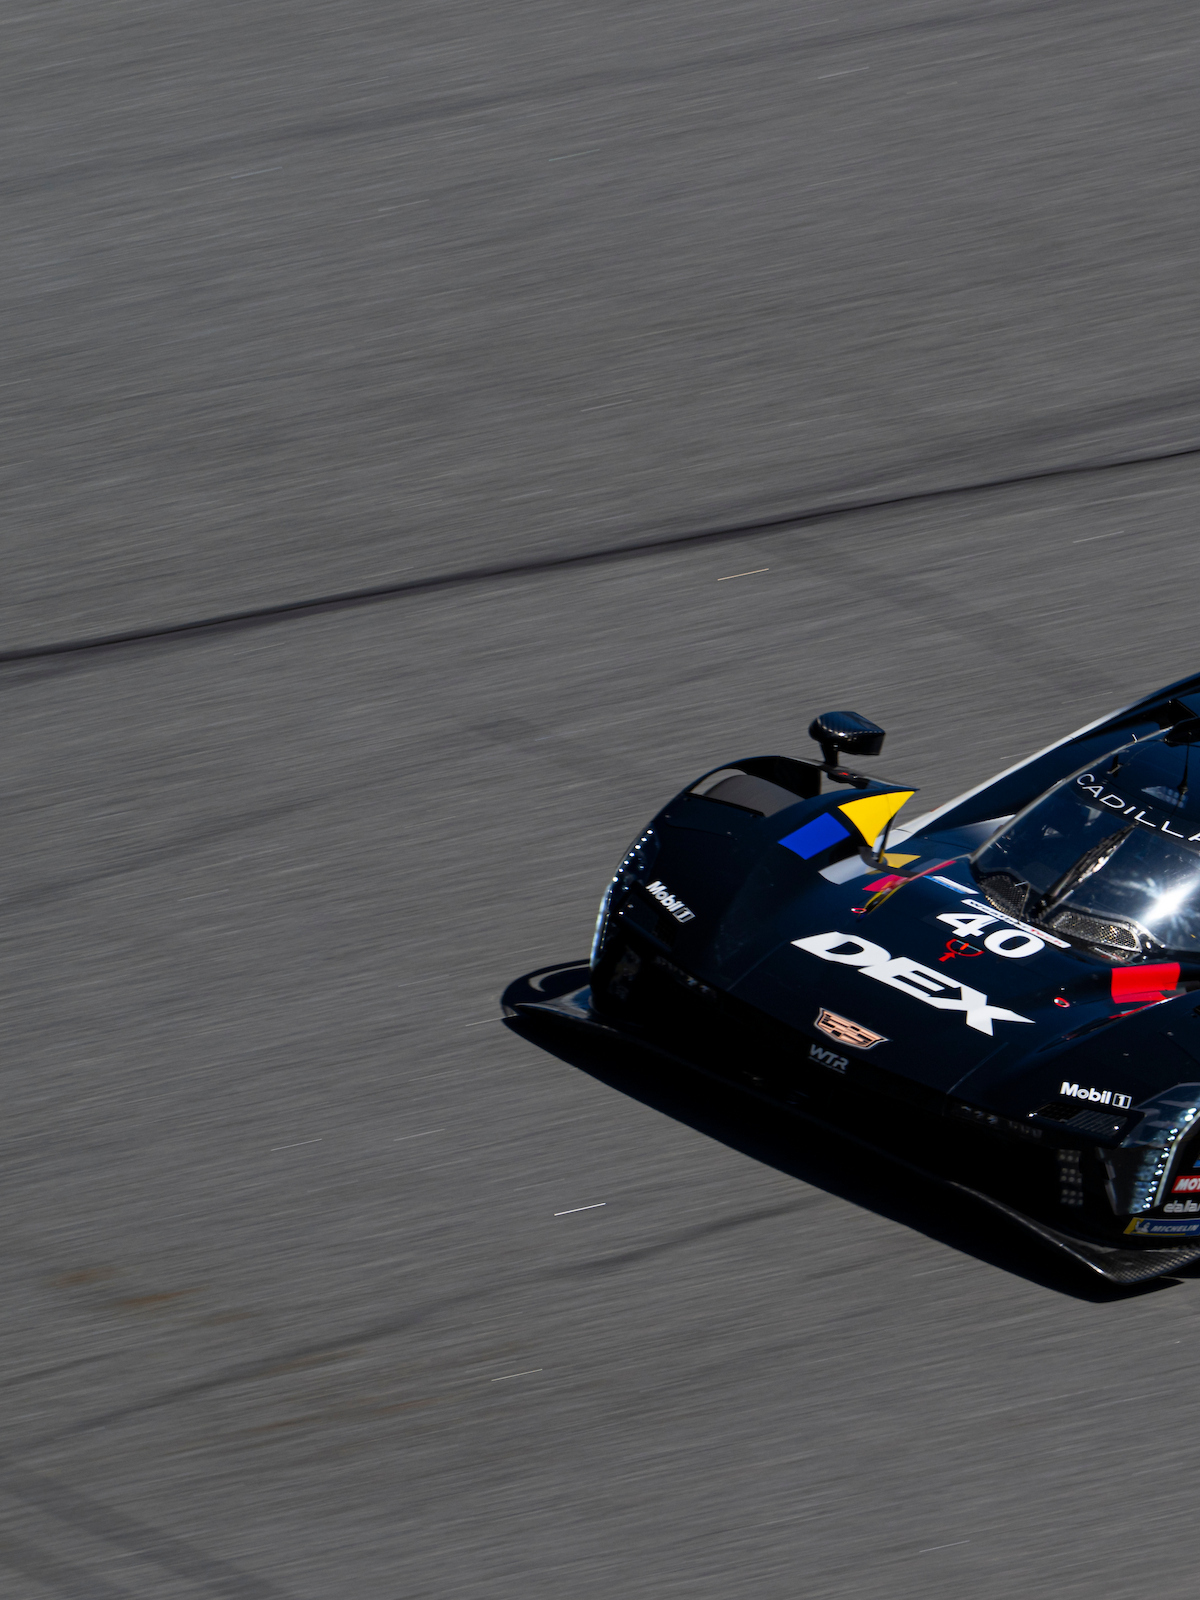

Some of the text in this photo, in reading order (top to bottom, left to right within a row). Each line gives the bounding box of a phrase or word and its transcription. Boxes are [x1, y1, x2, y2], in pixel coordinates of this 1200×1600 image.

[645, 880, 685, 912] Mobil
[936, 913, 1045, 958] 40
[790, 931, 1036, 1036] DEX
[810, 1043, 849, 1070] WTR
[1060, 1081, 1112, 1104] Mobil
[1150, 1224, 1199, 1232] MICHELIN
